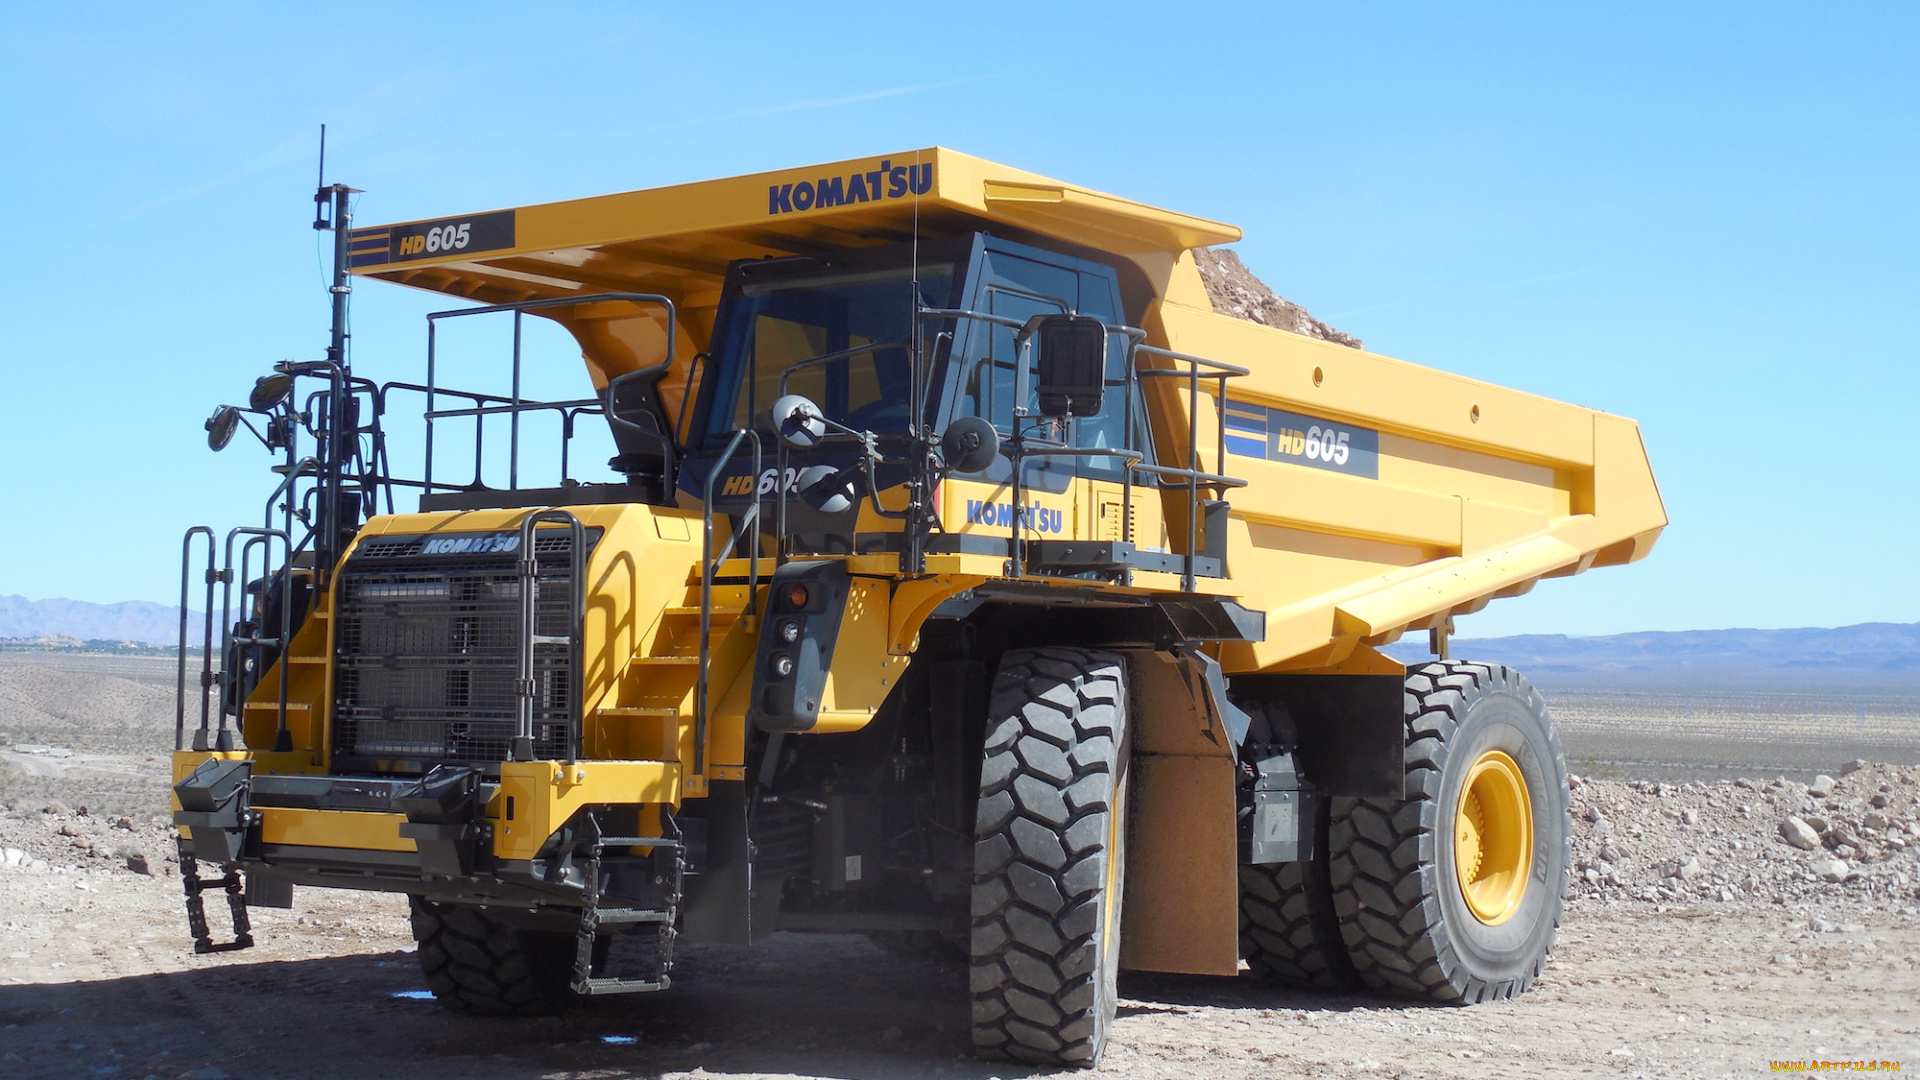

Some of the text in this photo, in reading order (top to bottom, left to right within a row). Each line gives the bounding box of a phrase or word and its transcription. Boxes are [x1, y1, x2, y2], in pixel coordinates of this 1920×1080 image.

[769, 160, 932, 215] KOMATSU
[399, 223, 471, 255] HD605
[1278, 425, 1350, 465] HD605
[422, 533, 520, 554] KOMATSU
